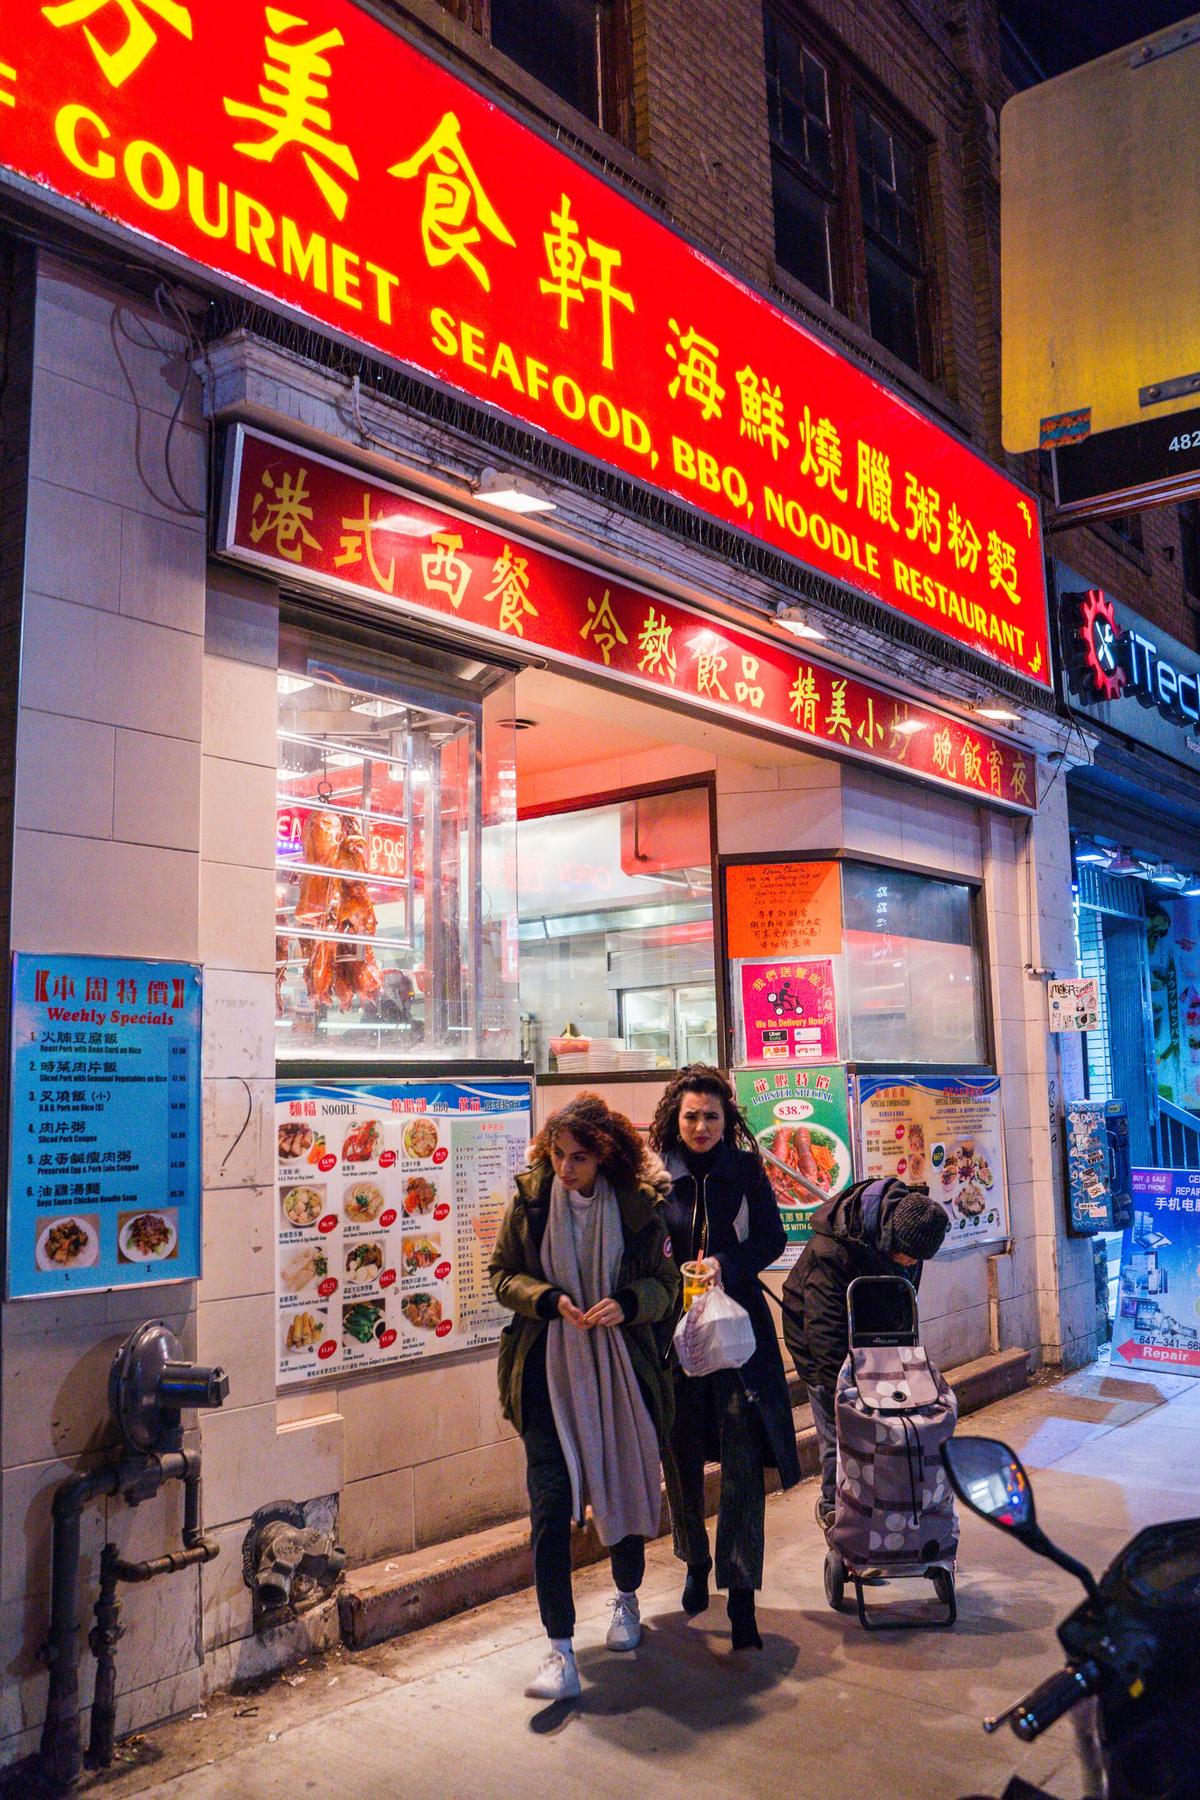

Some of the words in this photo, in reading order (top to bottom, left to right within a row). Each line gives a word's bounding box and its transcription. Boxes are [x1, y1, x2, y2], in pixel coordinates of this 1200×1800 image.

[55, 104, 400, 325] GOURMET
[430, 307, 658, 468] SEAFOOD,
[671, 436, 754, 518] BBQ,
[765, 487, 881, 579] NOODLE
[894, 559, 1025, 655] RESTAURANT
[249, 469, 539, 637] 港式西餐
[579, 588, 765, 708] 冷熱飲品
[1129, 630, 1200, 720] iTec
[276, 815, 302, 843] EA
[371, 835, 405, 859] ood
[47, 1007, 106, 1025] Weekly
[110, 1010, 174, 1027] Specials
[755, 1020, 767, 1029] We
[767, 1020, 778, 1028] Do
[779, 1018, 807, 1027] Delivery
[59, 1045, 72, 1053] Pork
[128, 1046, 141, 1054] Rice
[40, 1074, 58, 1082] Sliced
[60, 1074, 72, 1082] Pork
[73, 1074, 86, 1082] with
[87, 1075, 113, 1083] Seasonal
[115, 1075, 145, 1083] Vegetables
[155, 1075, 167, 1083] Rice
[751, 1088, 792, 1106] LOBSTER
[794, 1088, 833, 1103] SPECIAL
[57, 1104, 71, 1112] Pork
[81, 1103, 94, 1111] Rice
[321, 1104, 357, 1115] NOODLE
[433, 1101, 449, 1113] BBQ
[39, 1121, 86, 1134] 肉片粥
[38, 1135, 58, 1144] Sliced
[59, 1135, 73, 1143] Pork
[74, 1134, 97, 1142] Congee
[38, 1166, 69, 1175] Preserved
[70, 1166, 81, 1175] Egg
[88, 1165, 102, 1173] Pork
[116, 1164, 139, 1173] Congee
[1152, 1175, 1167, 1183] SALE
[1188, 1174, 1200, 1184] CE
[37, 1198, 52, 1207] Soya
[54, 1198, 72, 1206] Sauce
[74, 1197, 98, 1205] Chicken
[122, 1194, 137, 1202] Soup
[791, 1223, 806, 1231] WITH
[1139, 1335, 1200, 1350] 647-341-66
[1143, 1346, 1189, 1361] Repair
